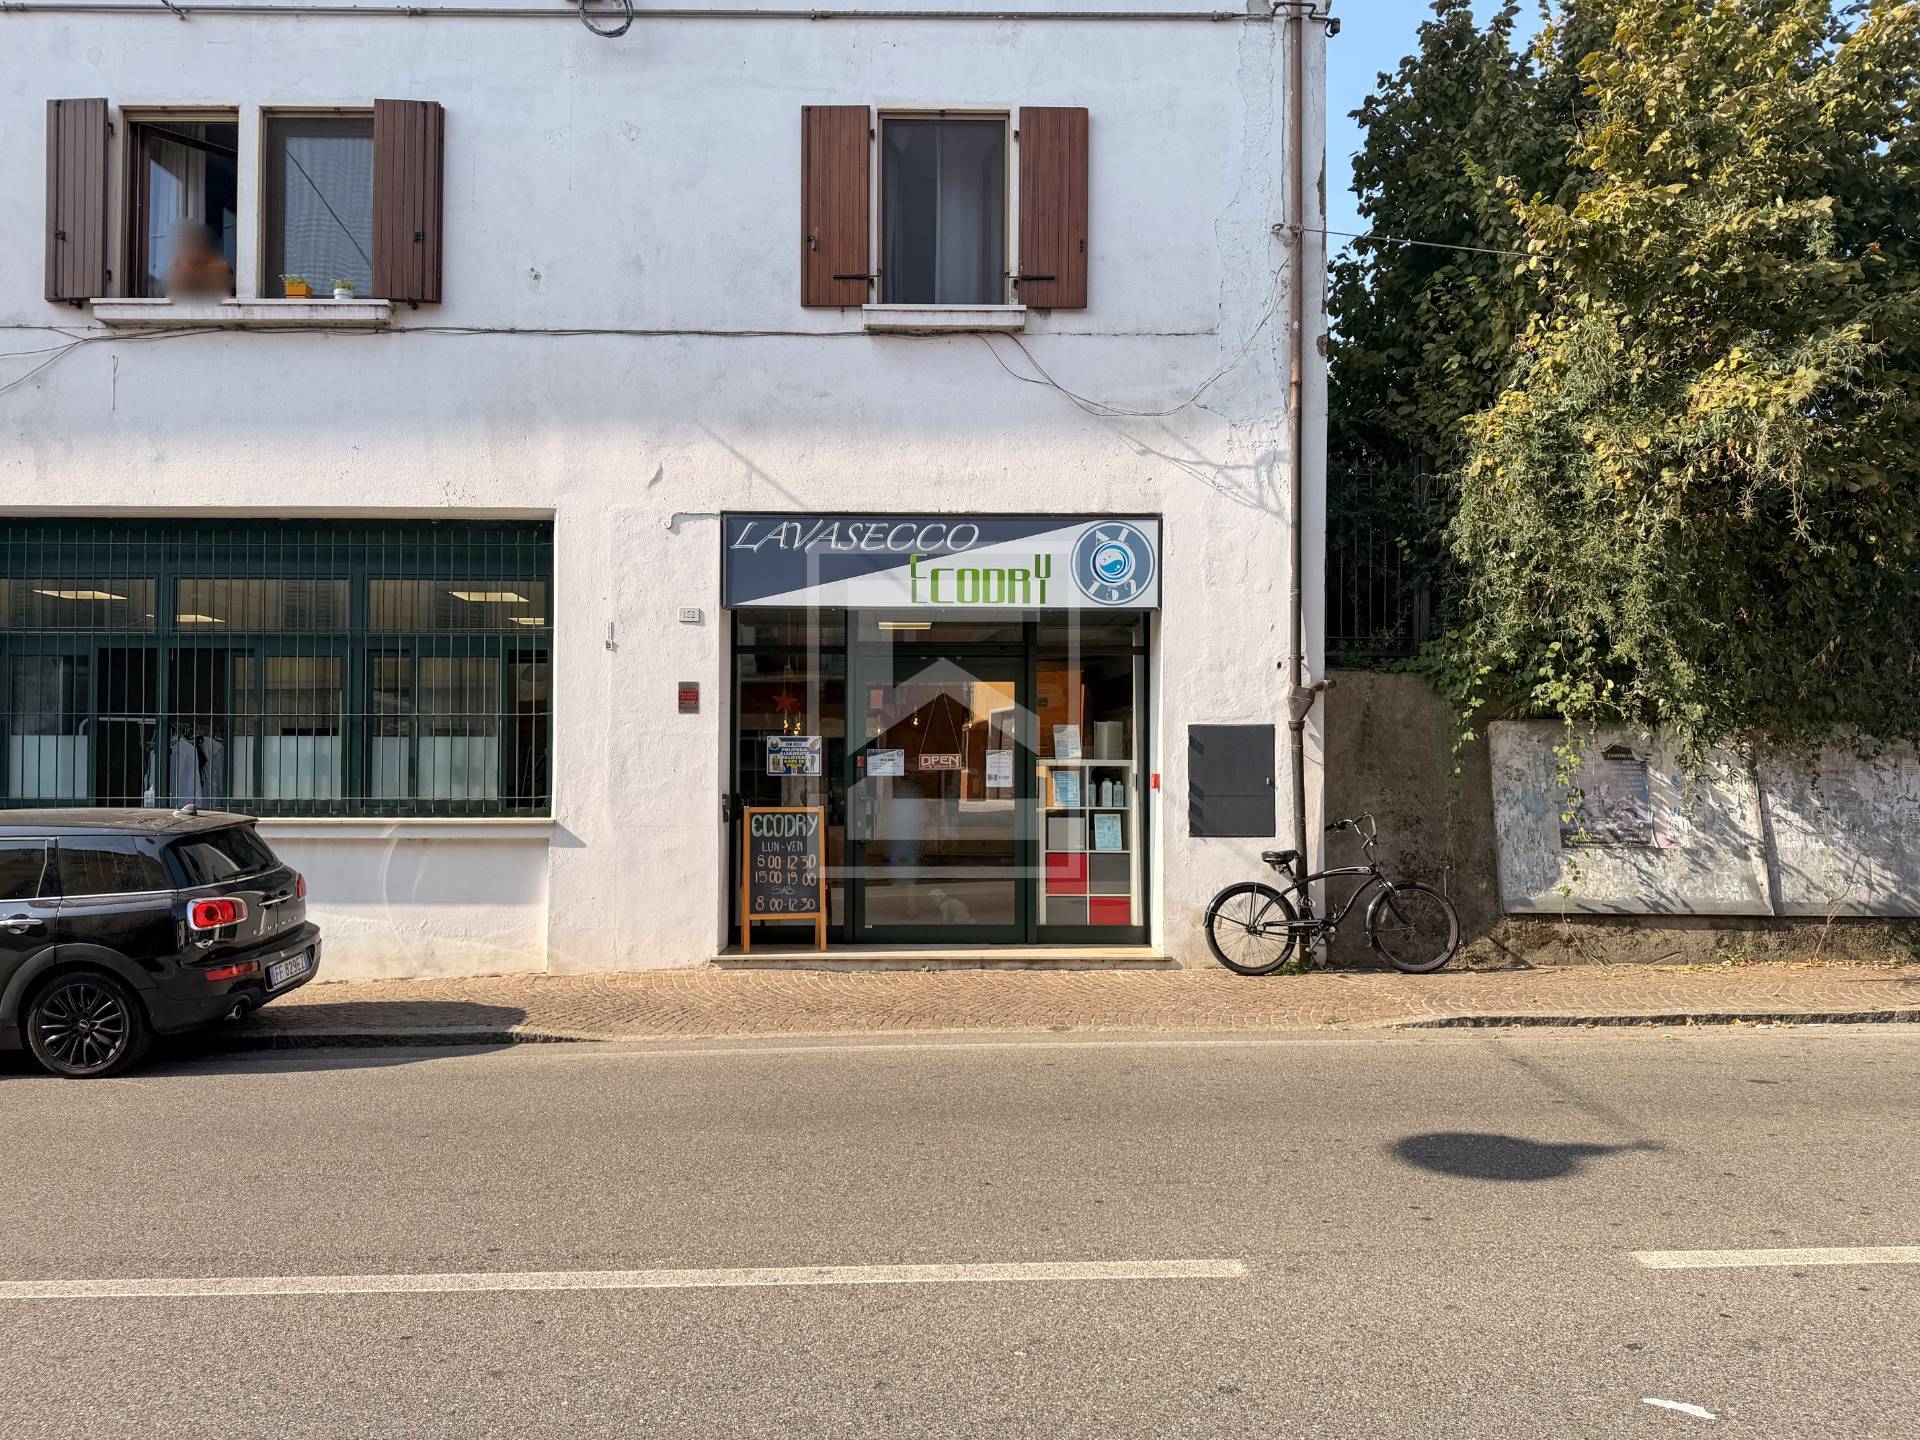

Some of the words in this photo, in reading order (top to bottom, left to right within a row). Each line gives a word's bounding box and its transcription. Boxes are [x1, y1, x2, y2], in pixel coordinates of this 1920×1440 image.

[729, 519, 980, 554] LAVASECCO
[910, 553, 1052, 605] ECODRY
[682, 610, 696, 619] 152
[920, 755, 960, 767] OPEN
[752, 813, 818, 837] ECODRY
